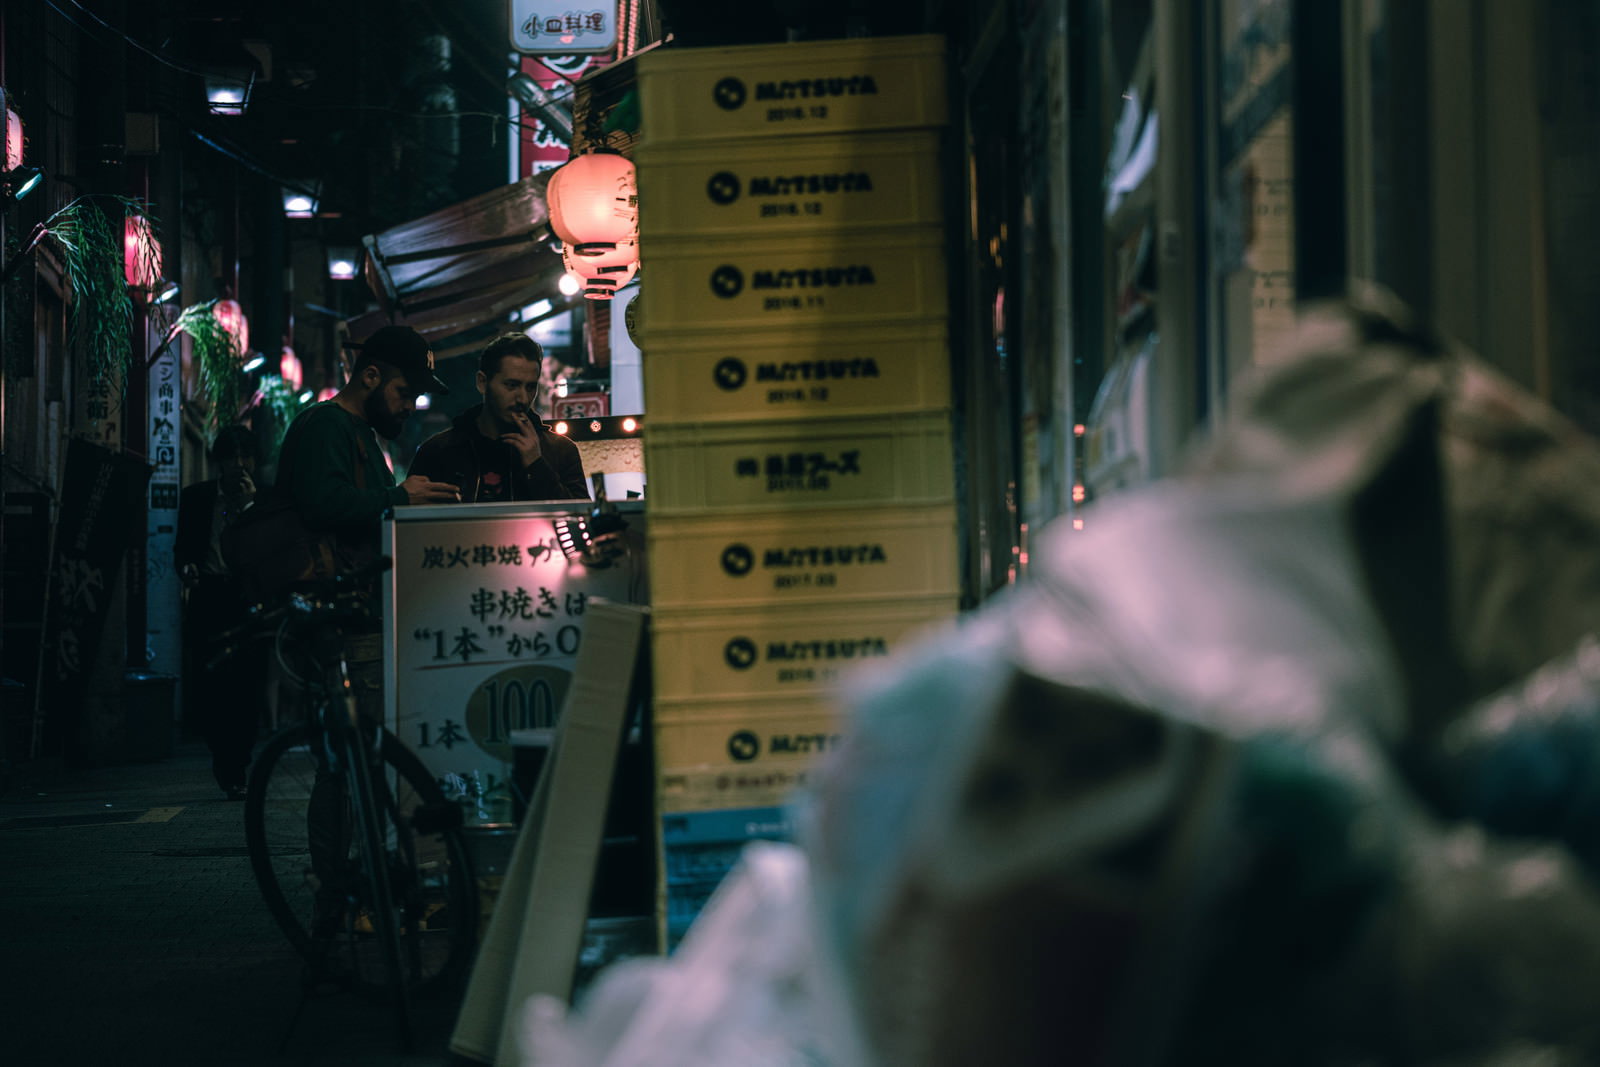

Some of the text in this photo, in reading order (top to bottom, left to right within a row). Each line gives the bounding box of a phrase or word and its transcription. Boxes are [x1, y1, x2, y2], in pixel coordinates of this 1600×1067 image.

[522, 12, 604, 36] 小皿料理
[422, 545, 522, 568] 炭火串焼
[470, 587, 586, 621] 串焼きは
[417, 720, 467, 749] 1本
